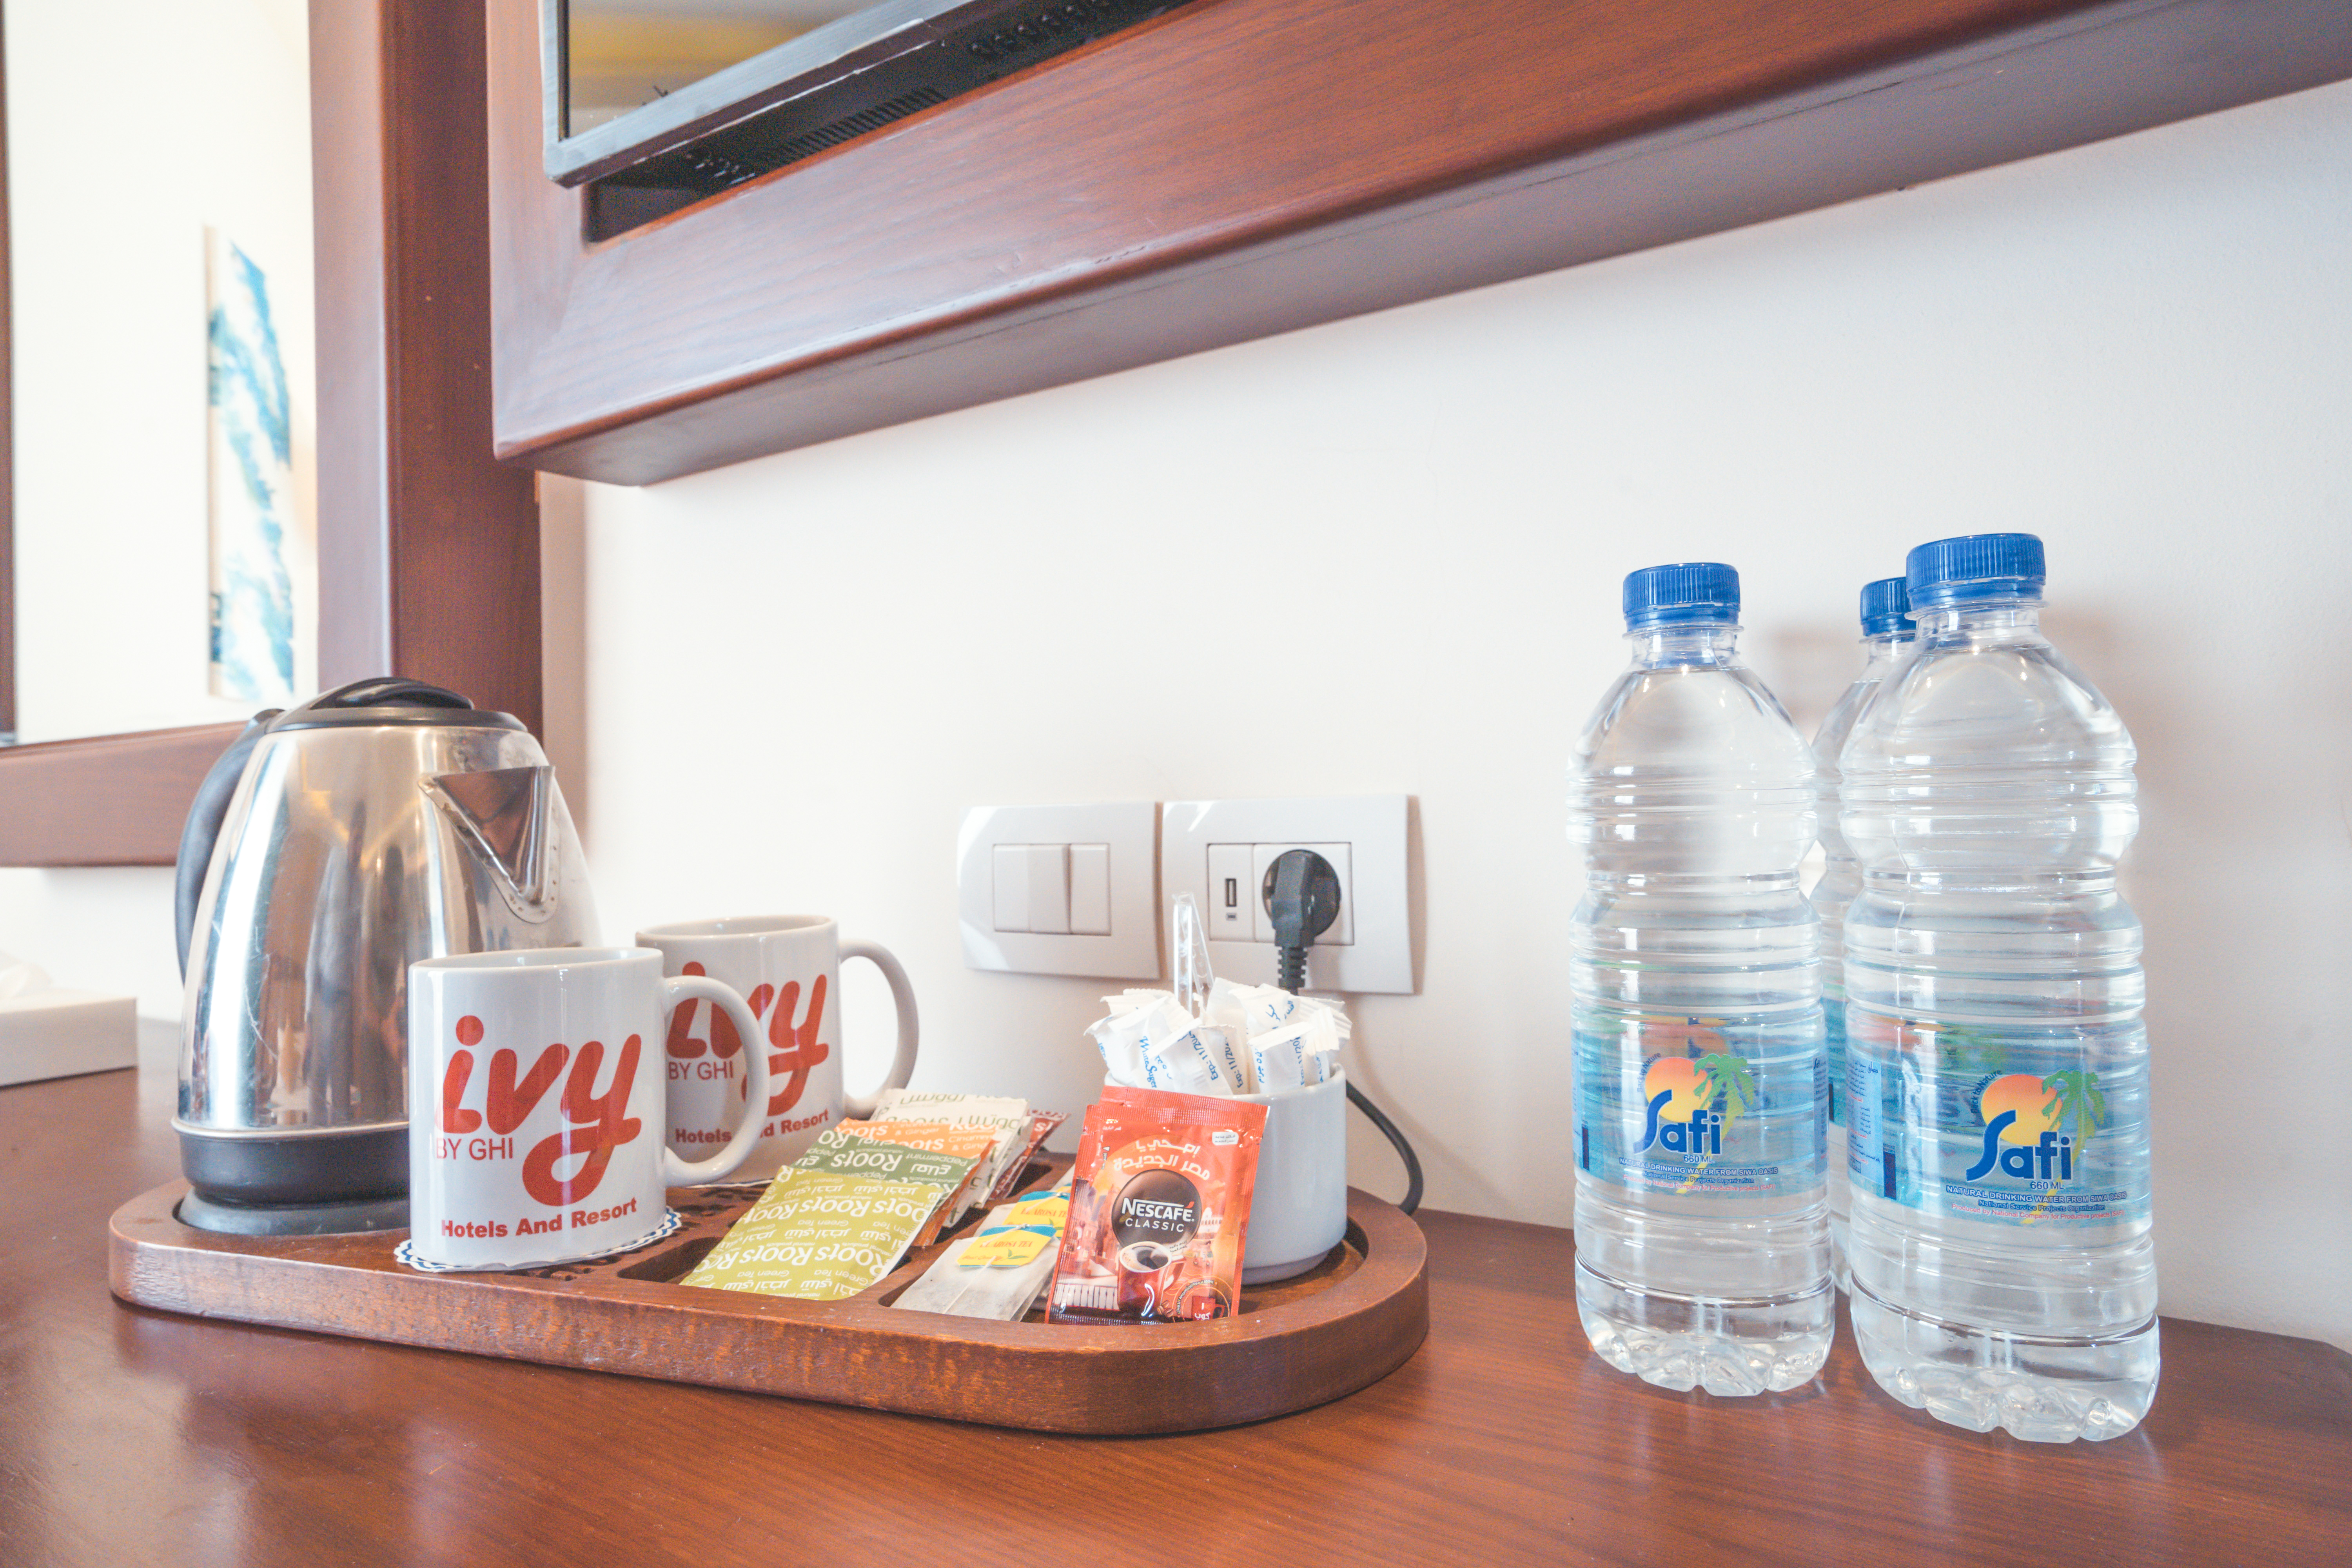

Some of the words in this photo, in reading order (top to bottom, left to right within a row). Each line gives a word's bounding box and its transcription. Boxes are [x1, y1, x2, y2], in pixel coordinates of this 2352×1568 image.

[666, 961, 829, 1116] ivy
[668, 1062, 690, 1080] BY
[697, 1060, 733, 1080] GHI
[1977, 1070, 2003, 1089] Nature
[435, 1015, 641, 1206] ivy
[781, 1108, 829, 1134] Resort
[1633, 1089, 1722, 1155] Safi
[675, 1128, 731, 1143] Hotels
[436, 1138, 462, 1160] BY
[469, 1138, 513, 1160] GHI
[1966, 1109, 2073, 1182] Safi
[831, 1150, 903, 1171] Roots
[906, 1153, 968, 1167] Peppermint
[1113, 1154, 1179, 1171] الجديدة
[1619, 1157, 1649, 1169] NATURAL
[1650, 1163, 1686, 1174] DRINKING
[1684, 1154, 1700, 1163] 660
[1702, 1155, 1715, 1163] ML
[1180, 1161, 1210, 1180] مصر
[1642, 1170, 1666, 1179] National
[1946, 1185, 1988, 1198] NATURAL
[1989, 1192, 2033, 1202] DRINKING
[2109, 1191, 2127, 1201] OASIS
[2030, 1181, 2049, 1190] 660
[737, 1203, 799, 1224] Root
[799, 1196, 871, 1217] Roots
[872, 1198, 928, 1222] oots
[1951, 1203, 1980, 1213] Produced
[1992, 1209, 2018, 1218] National
[1978, 1199, 2009, 1209] National
[2038, 1205, 2066, 1213] Projects
[2067, 1204, 2105, 1213] Organization
[441, 1220, 508, 1238] Hotels
[516, 1214, 562, 1236] And
[572, 1197, 637, 1228] Resort
[1125, 1218, 1184, 1232] CLASSIC
[784, 1228, 815, 1239] شاي
[860, 1230, 891, 1242] شاي
[739, 1245, 814, 1266] Roots
[814, 1243, 885, 1276] Roots
[800, 1278, 833, 1291] شاي
[835, 1270, 869, 1285] Green
